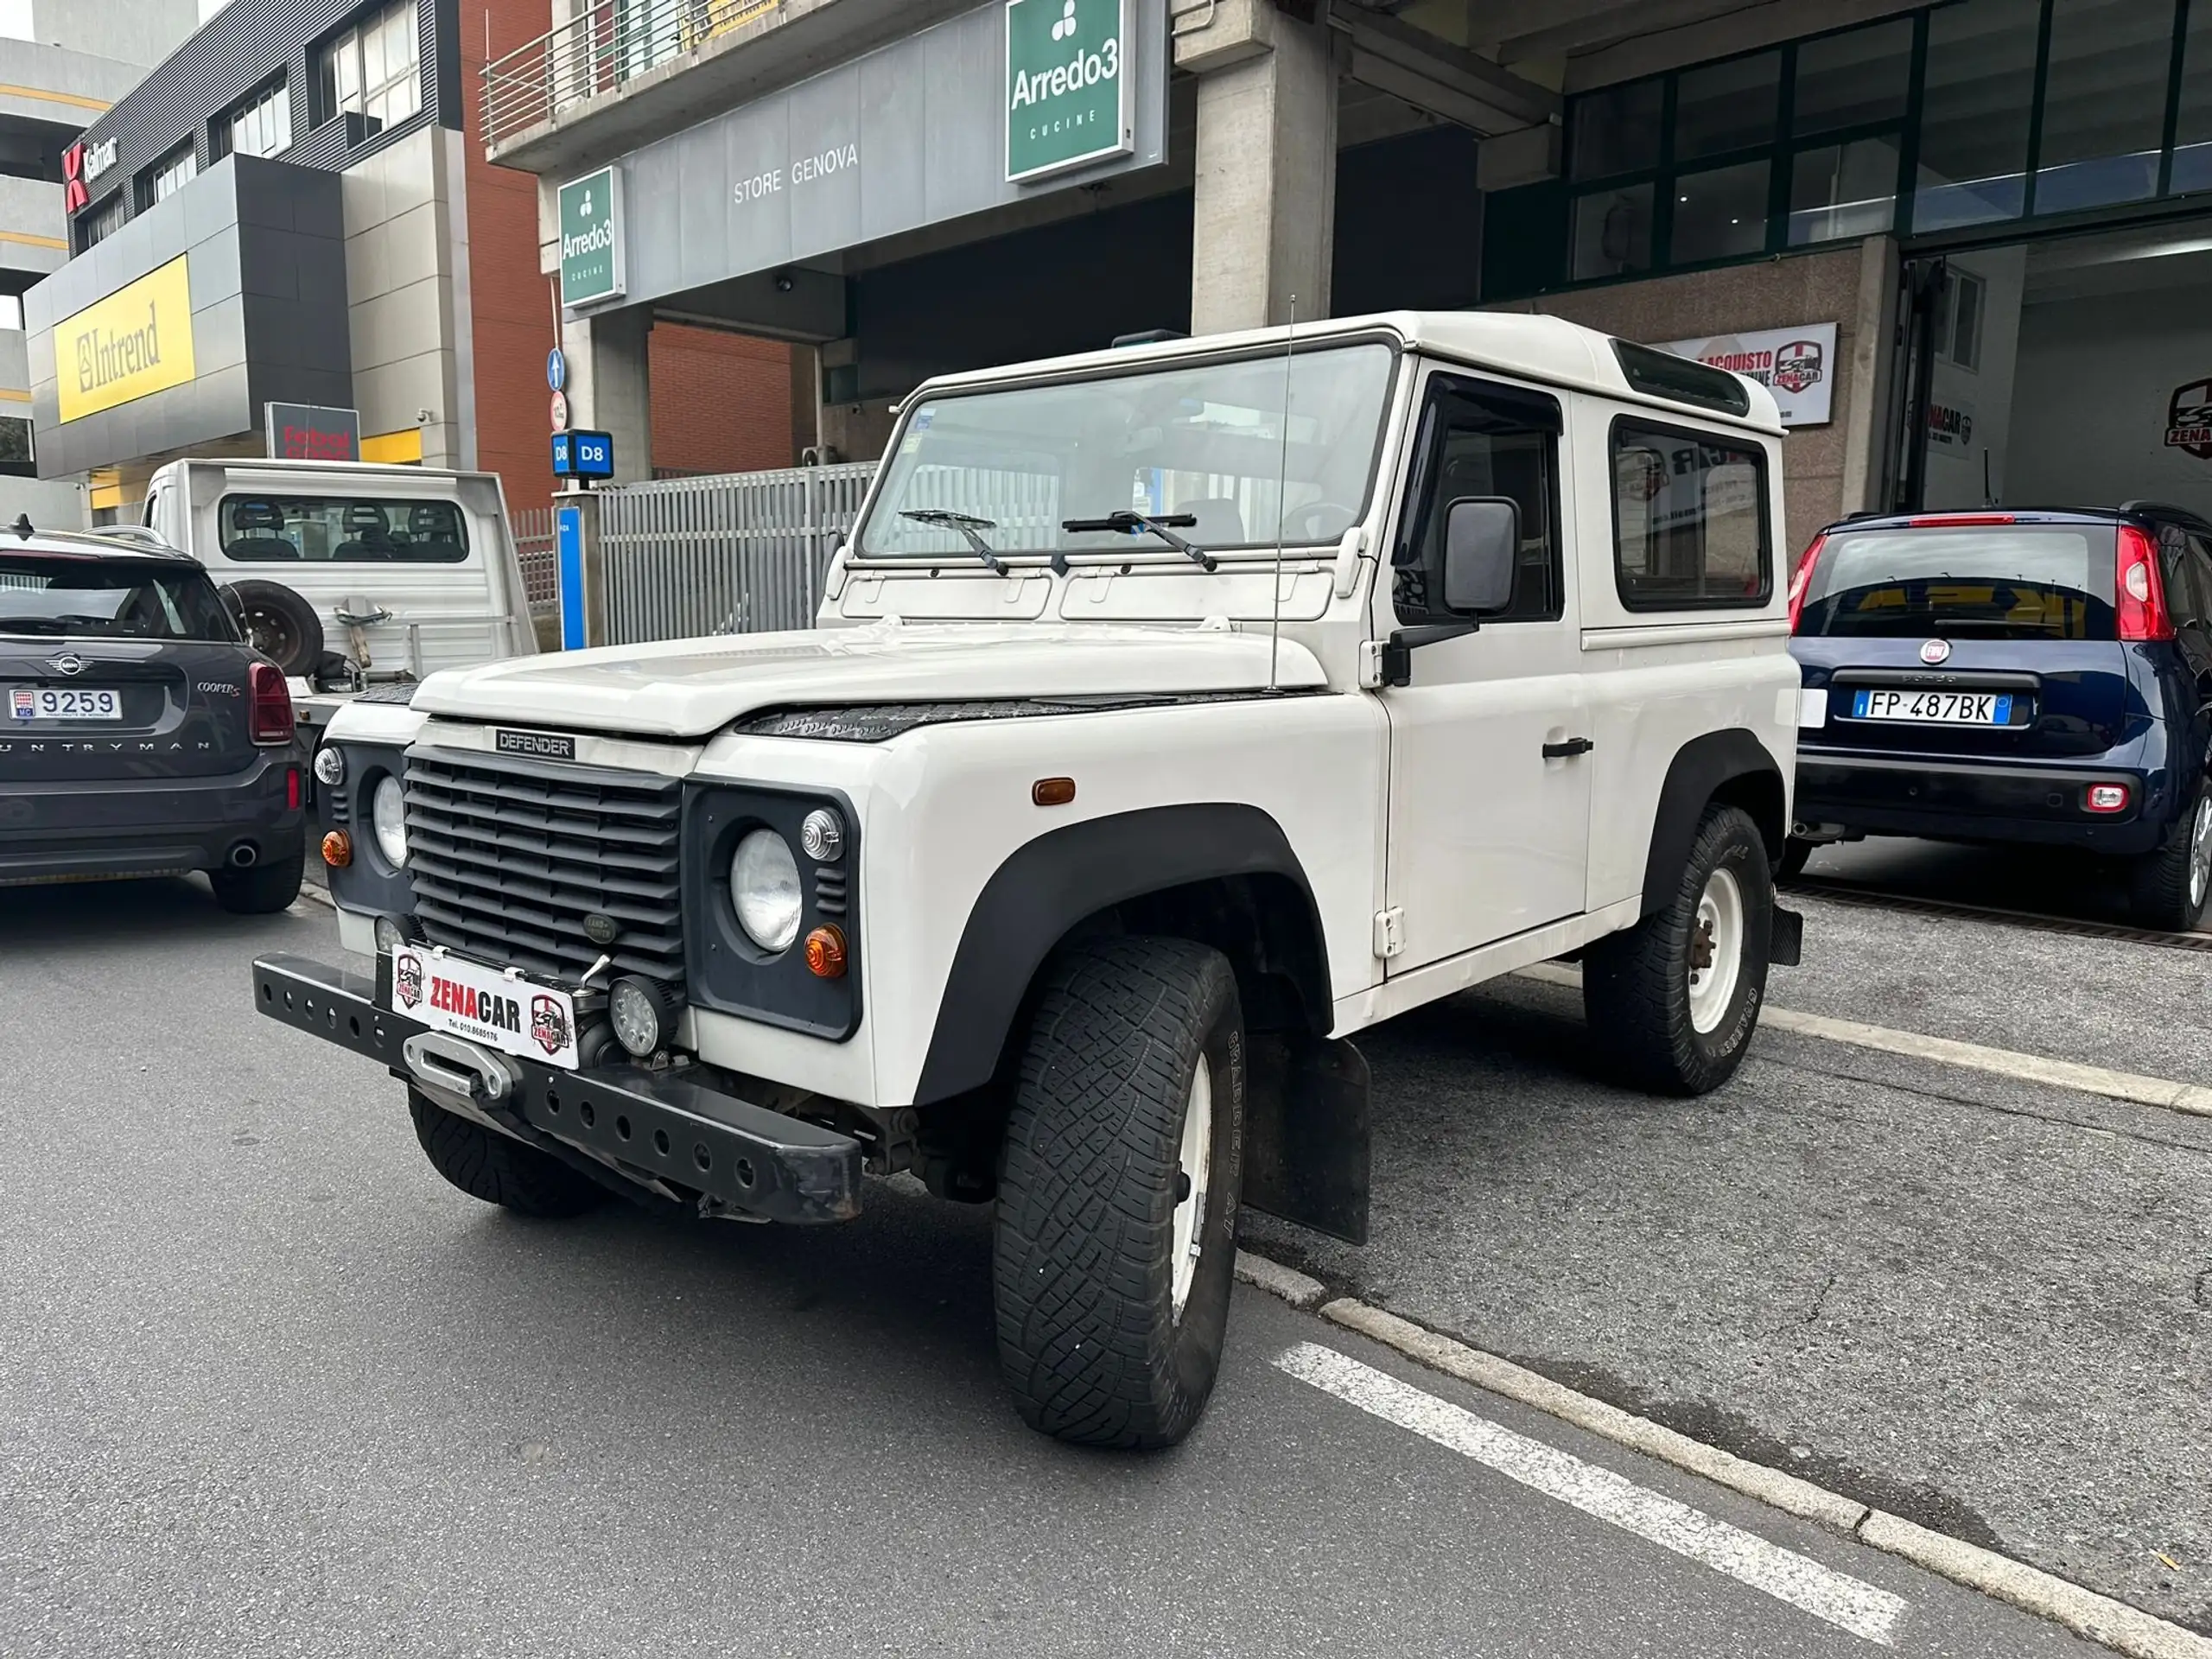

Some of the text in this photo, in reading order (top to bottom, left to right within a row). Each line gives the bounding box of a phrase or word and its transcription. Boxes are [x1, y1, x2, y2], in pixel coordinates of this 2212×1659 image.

[1011, 38, 1118, 111] Arredo3
[1030, 110, 1096, 140] CUCINE
[734, 143, 858, 204] STORE GENOVA
[563, 219, 612, 260] Arredo3
[571, 264, 603, 282] CUCINE
[92, 297, 161, 388] Intrend
[1776, 371, 1819, 385] ZENACAR
[556, 446, 568, 460] D8
[581, 446, 604, 461] D8
[1927, 645, 1944, 657] FIAT
[197, 681, 233, 694] COOPER
[41, 691, 114, 713] 9259
[1871, 692, 1992, 721] FP 487BK
[500, 733, 569, 756] DEFENDER
[430, 976, 521, 1033] ZENACAR
[533, 1027, 567, 1045] ZENACAR
[1228, 1030, 1243, 1177] GRABBER
